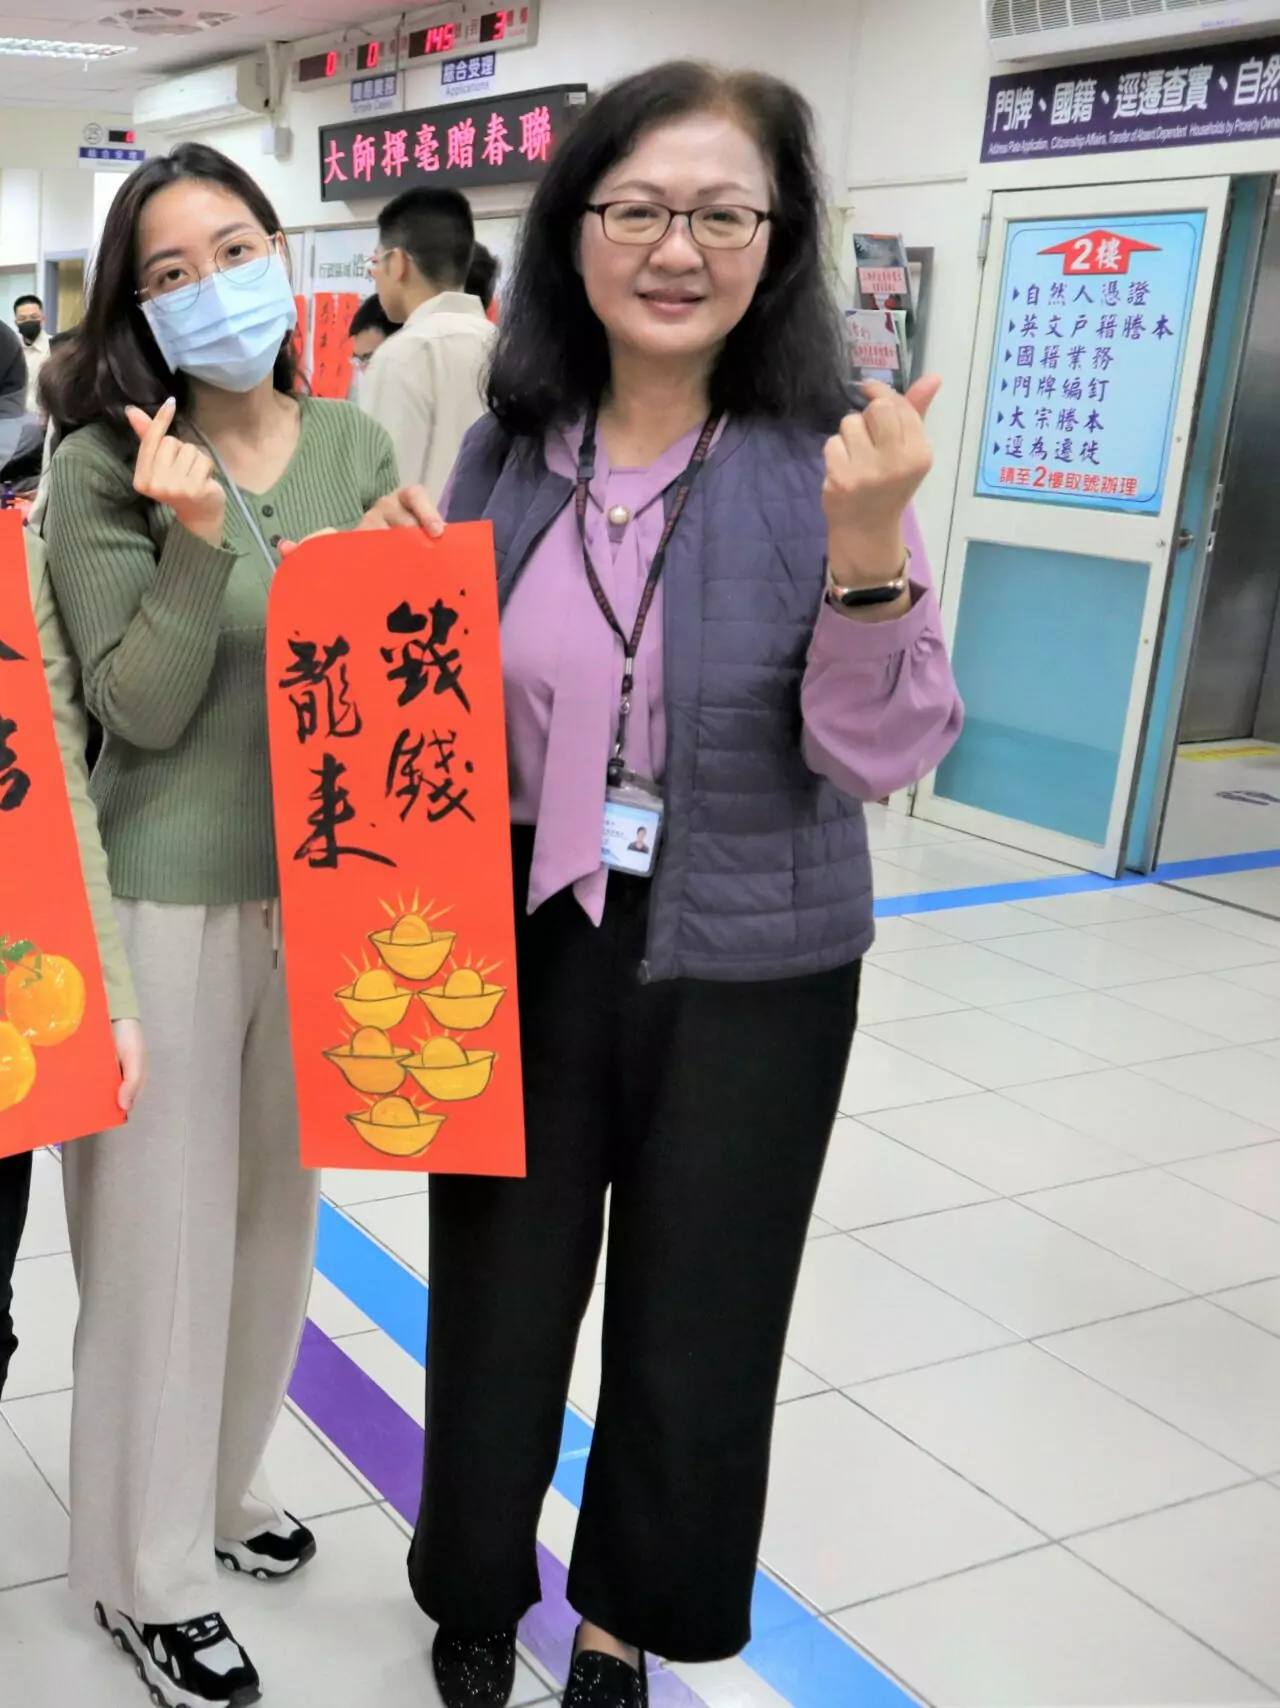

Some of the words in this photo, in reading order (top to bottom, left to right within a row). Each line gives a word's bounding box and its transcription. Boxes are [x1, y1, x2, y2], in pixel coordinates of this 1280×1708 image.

[424, 23, 455, 54] 145
[492, 10, 507, 41] 3
[324, 50, 339, 79] 0
[365, 41, 381, 69] 0
[443, 54, 495, 83] 綜合受理
[445, 81, 490, 96] Applications
[323, 105, 554, 184] 大師揮毫贈春聯
[1051, 134, 1086, 149] Citizenship
[1156, 125, 1188, 141] Dependent
[1189, 120, 1225, 137] Households
[1226, 119, 1234, 136] by
[1069, 237, 1123, 271] 2樓
[1026, 280, 1152, 308] 自然人憑證
[1019, 313, 1175, 341] 英文戶籍謄本
[1016, 344, 1115, 371] 國籍業務
[1013, 375, 1110, 403] 門牌編釘
[1009, 405, 1105, 433] 大宗謄本
[1004, 435, 1102, 466] 逕為遷徙
[999, 466, 1139, 497] 請至2樓取號辦理
[278, 634, 398, 870] 龍來
